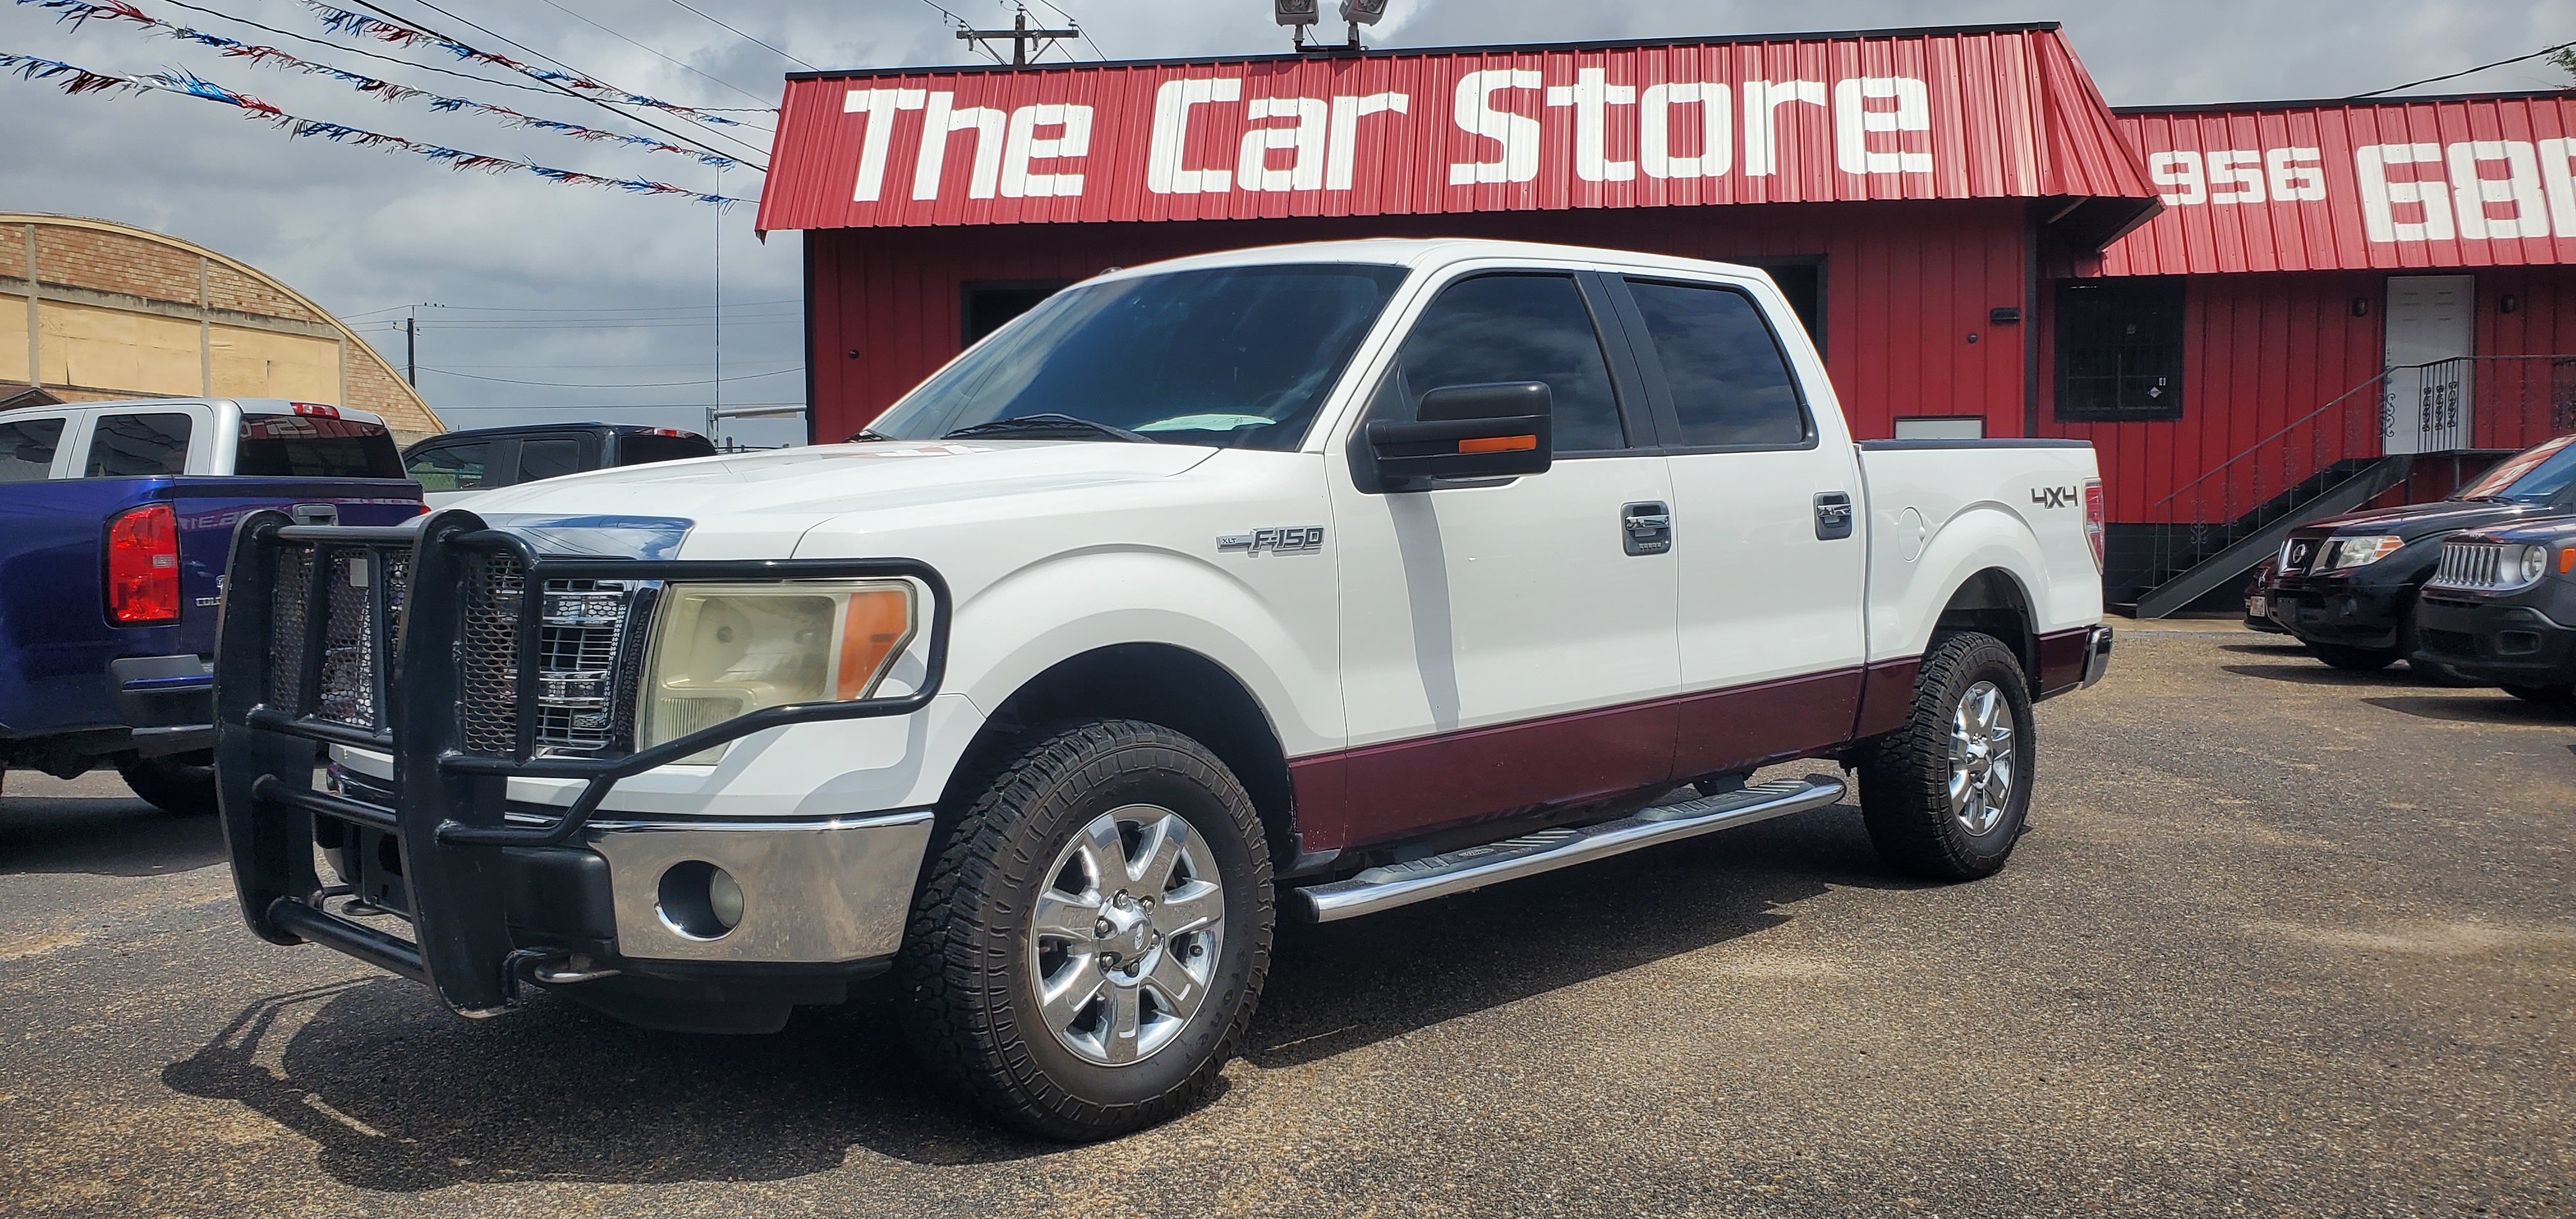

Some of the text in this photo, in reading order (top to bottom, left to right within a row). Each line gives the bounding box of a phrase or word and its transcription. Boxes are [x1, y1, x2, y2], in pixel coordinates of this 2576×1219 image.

[843, 68, 1933, 203] The Car Store
[2149, 147, 2326, 206] 956
[2030, 486, 2078, 509] 4X4
[1251, 526, 1324, 551] F-150
